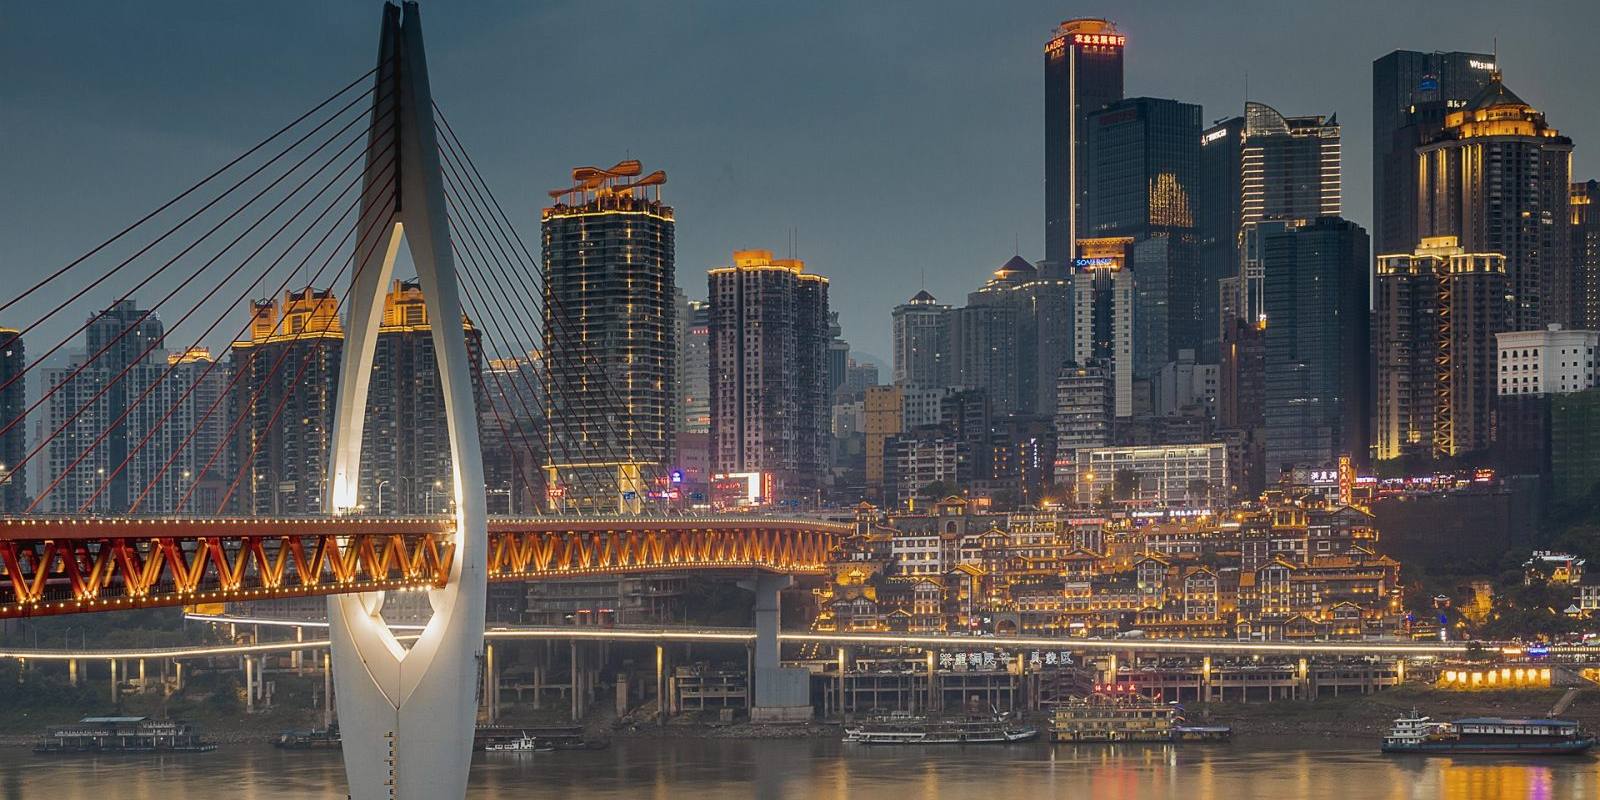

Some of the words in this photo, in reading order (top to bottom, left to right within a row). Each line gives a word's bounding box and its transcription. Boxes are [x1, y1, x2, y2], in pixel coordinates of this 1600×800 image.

[1075, 34, 1126, 46] 农业发展银行
